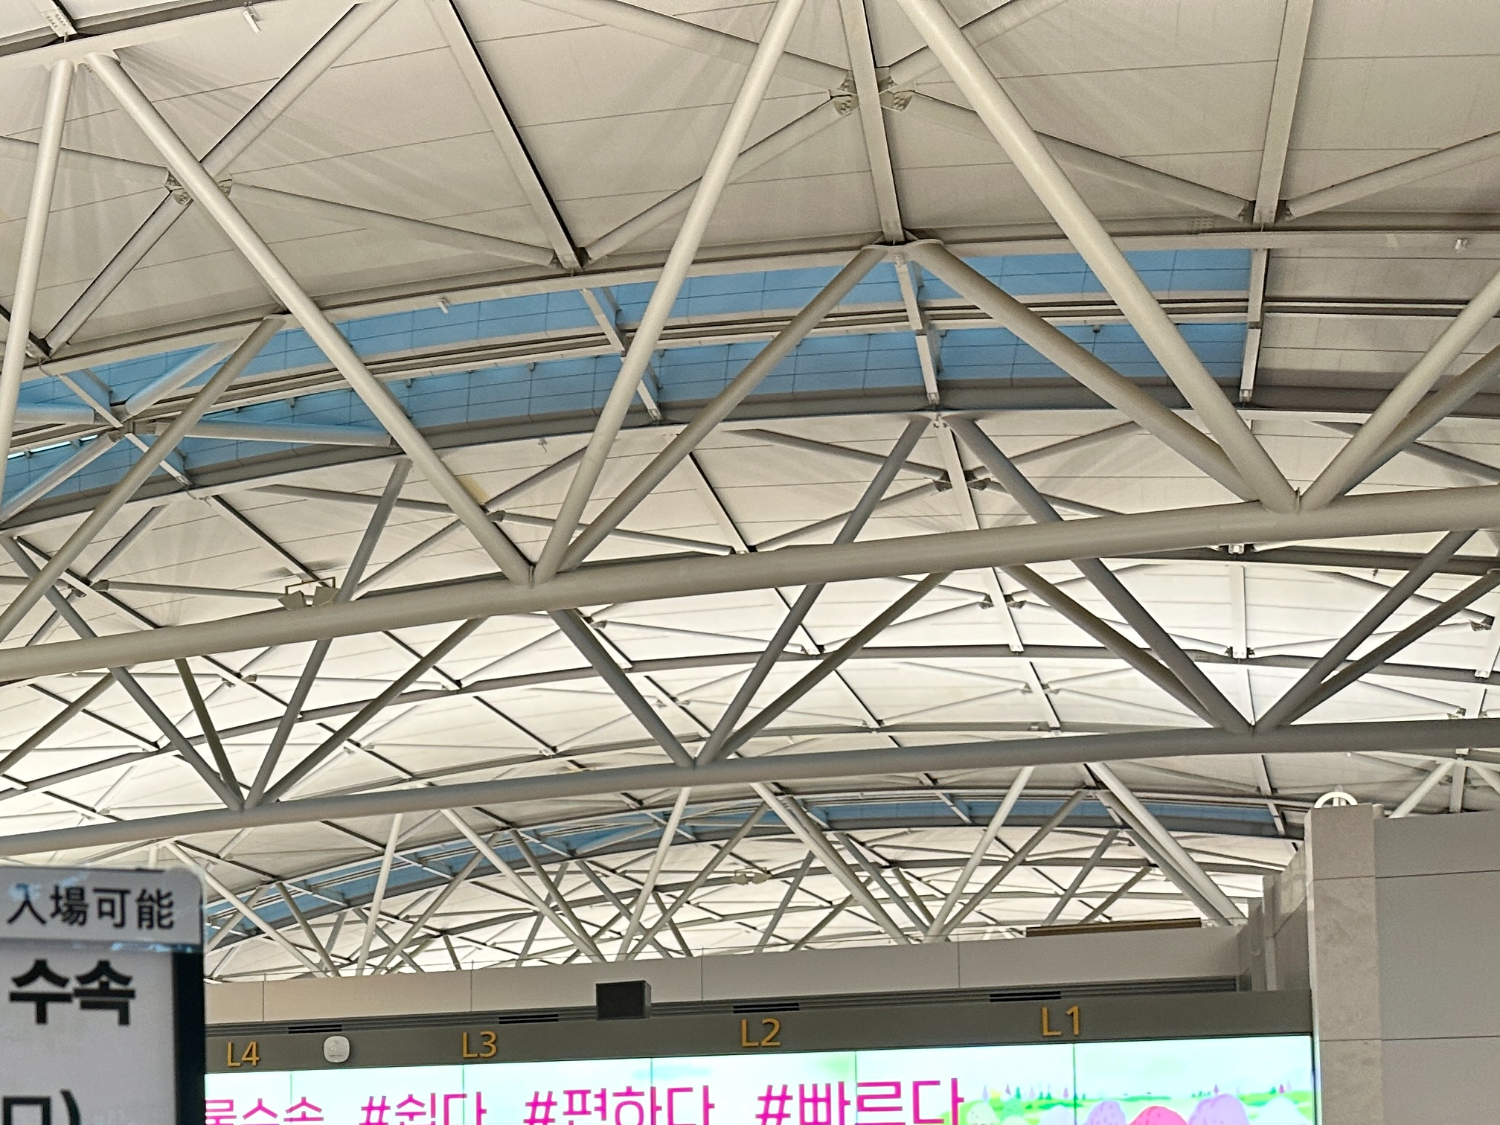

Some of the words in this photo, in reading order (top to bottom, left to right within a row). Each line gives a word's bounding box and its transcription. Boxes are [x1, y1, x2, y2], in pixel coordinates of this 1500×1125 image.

[9, 959, 136, 1026] 수속
[741, 1018, 781, 1049] L2
[1040, 1005, 1082, 1037] L1
[226, 1040, 261, 1068] L4
[462, 1030, 498, 1060] L3
